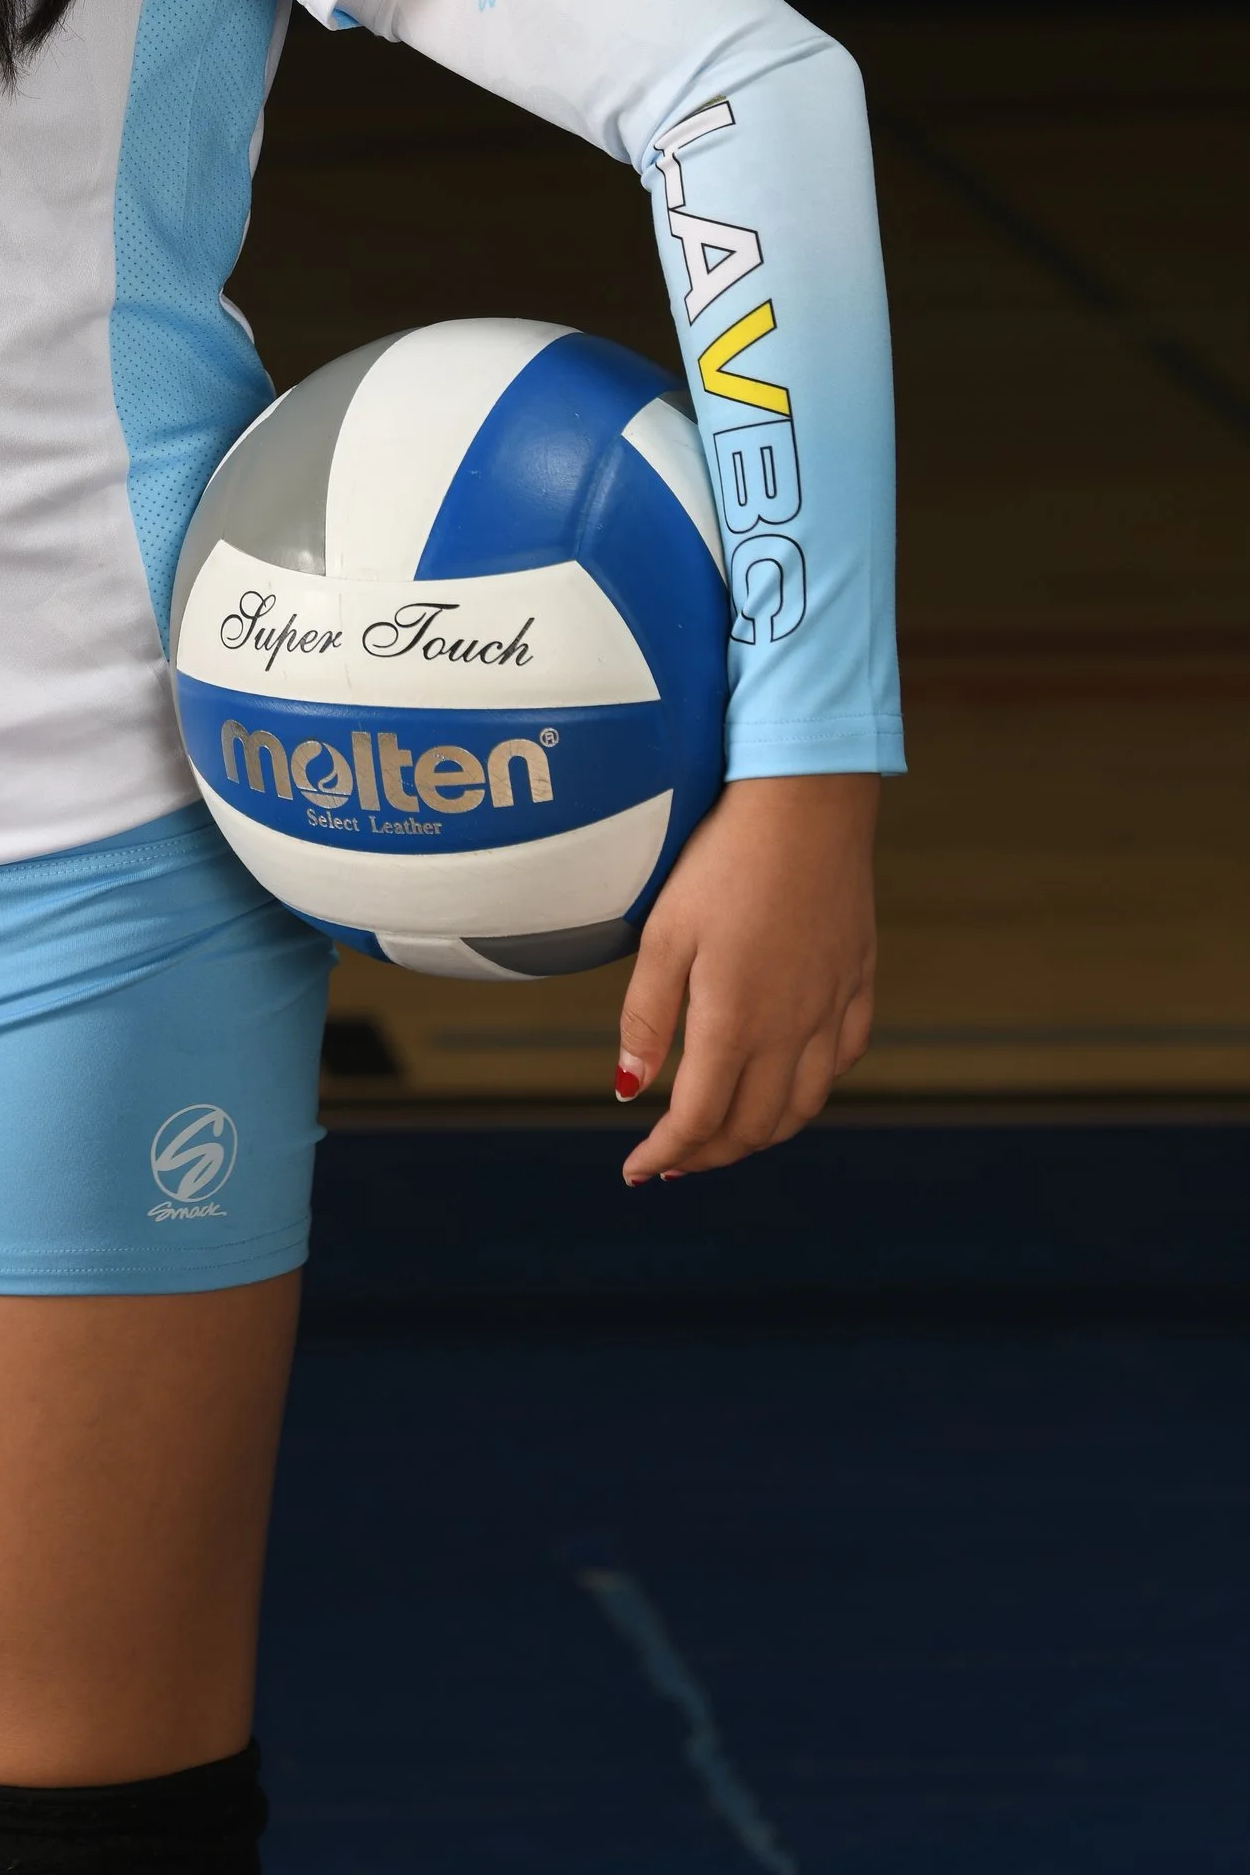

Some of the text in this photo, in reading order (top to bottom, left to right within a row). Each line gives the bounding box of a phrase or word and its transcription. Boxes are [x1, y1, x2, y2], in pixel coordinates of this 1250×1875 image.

[654, 99, 807, 645] LAVBC
[220, 590, 536, 672] Super Touch
[306, 808, 443, 835] Select Leather
[147, 1201, 228, 1223] Smack
